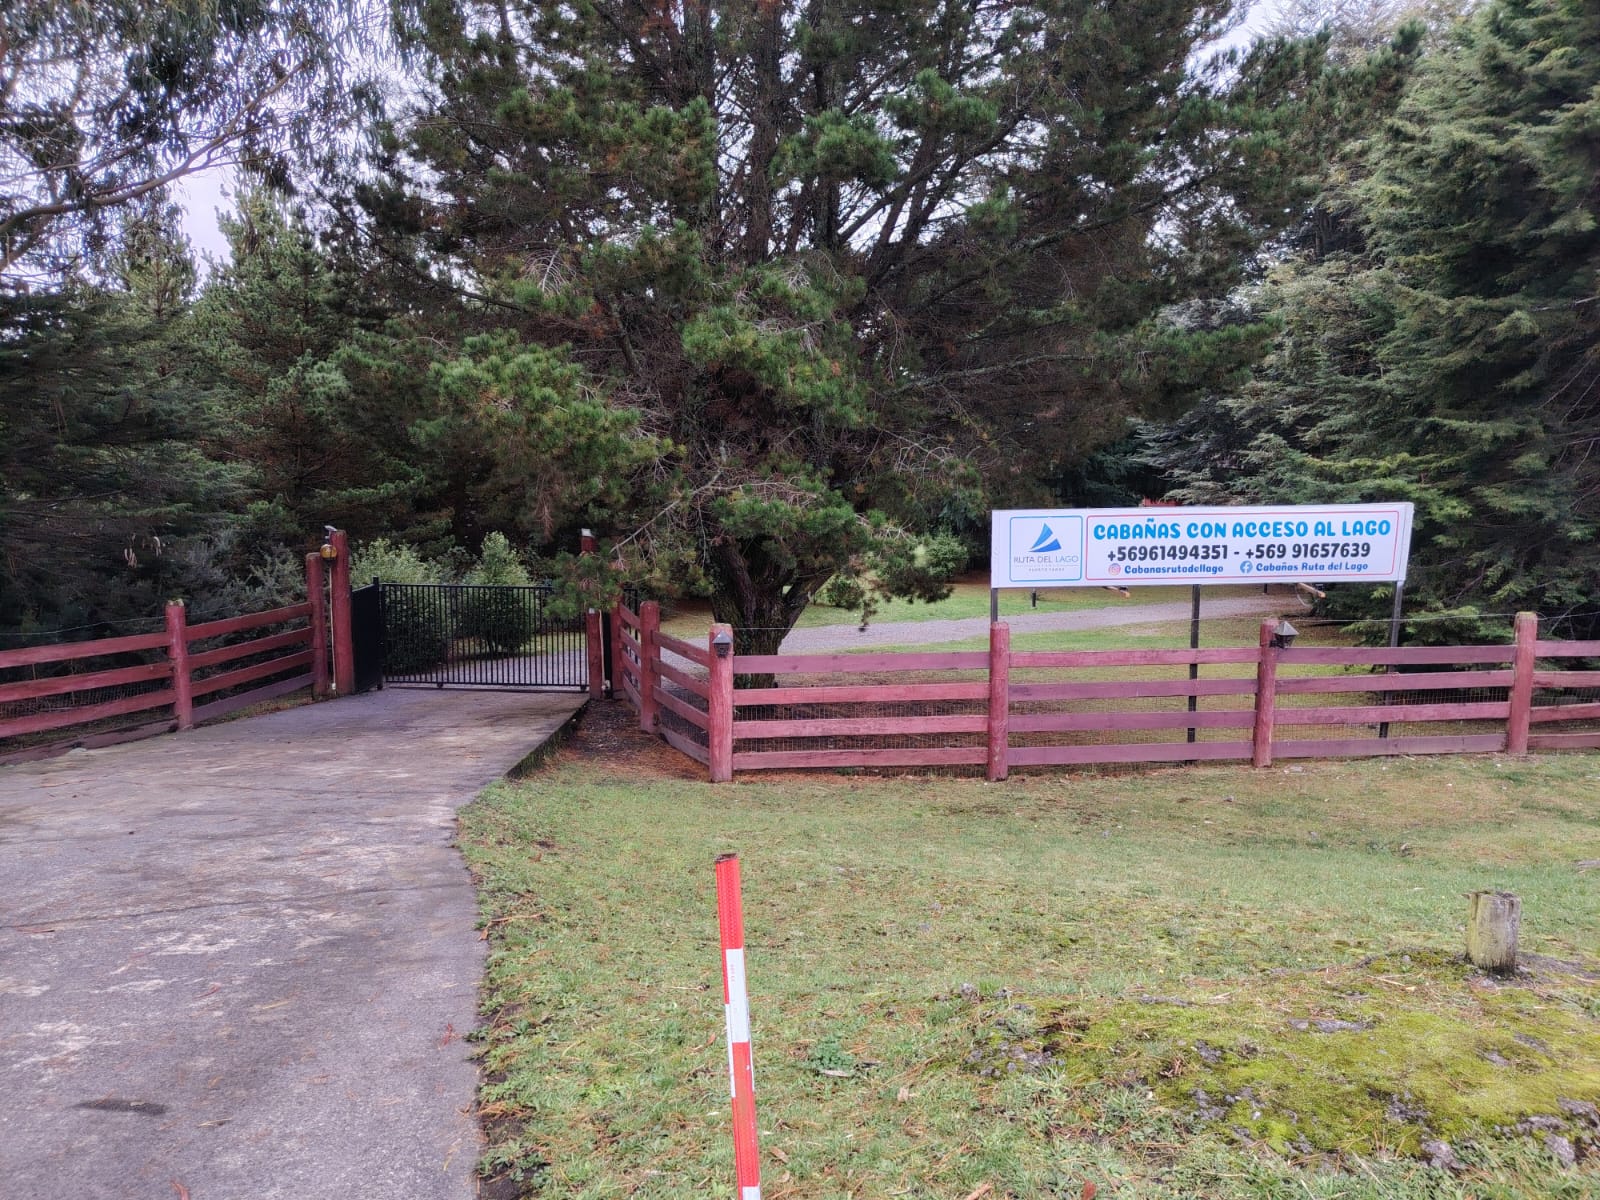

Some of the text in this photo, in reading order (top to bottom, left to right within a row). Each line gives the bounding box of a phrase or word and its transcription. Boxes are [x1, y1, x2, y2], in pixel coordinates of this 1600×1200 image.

[1093, 518, 1391, 540] CABAÑAS CON ACCESO AL LAGO
[1107, 545, 1228, 562] +56961494351
[1245, 543, 1286, 560] +569
[1292, 542, 1371, 559] 91657639
[1124, 564, 1223, 574] Cabanasrutadellago
[1256, 561, 1368, 572] Cabañas Ruta del Lago
